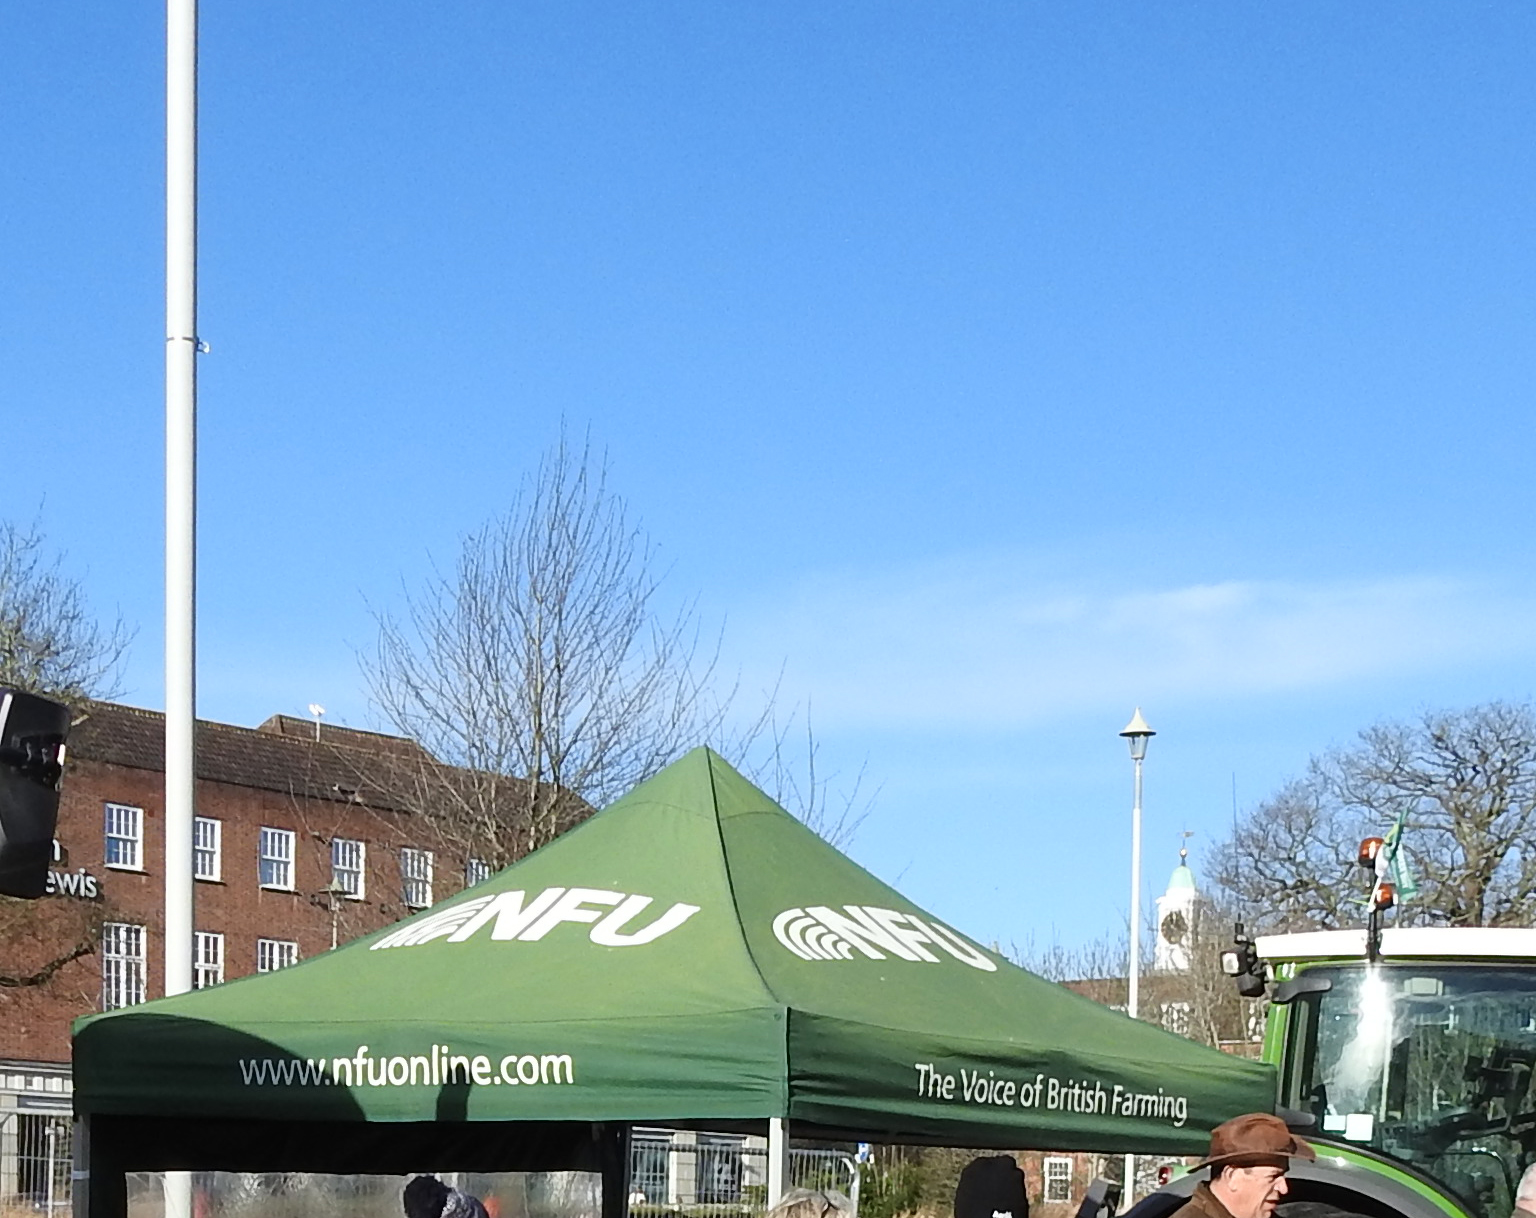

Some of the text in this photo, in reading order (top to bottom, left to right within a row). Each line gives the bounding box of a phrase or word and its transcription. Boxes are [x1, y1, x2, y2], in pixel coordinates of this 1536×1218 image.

[446, 887, 701, 947] NFU
[805, 904, 998, 972] NFU
[238, 1044, 574, 1087] www.nfuonline.com
[915, 1062, 1188, 1128] The Voice of British Farming
